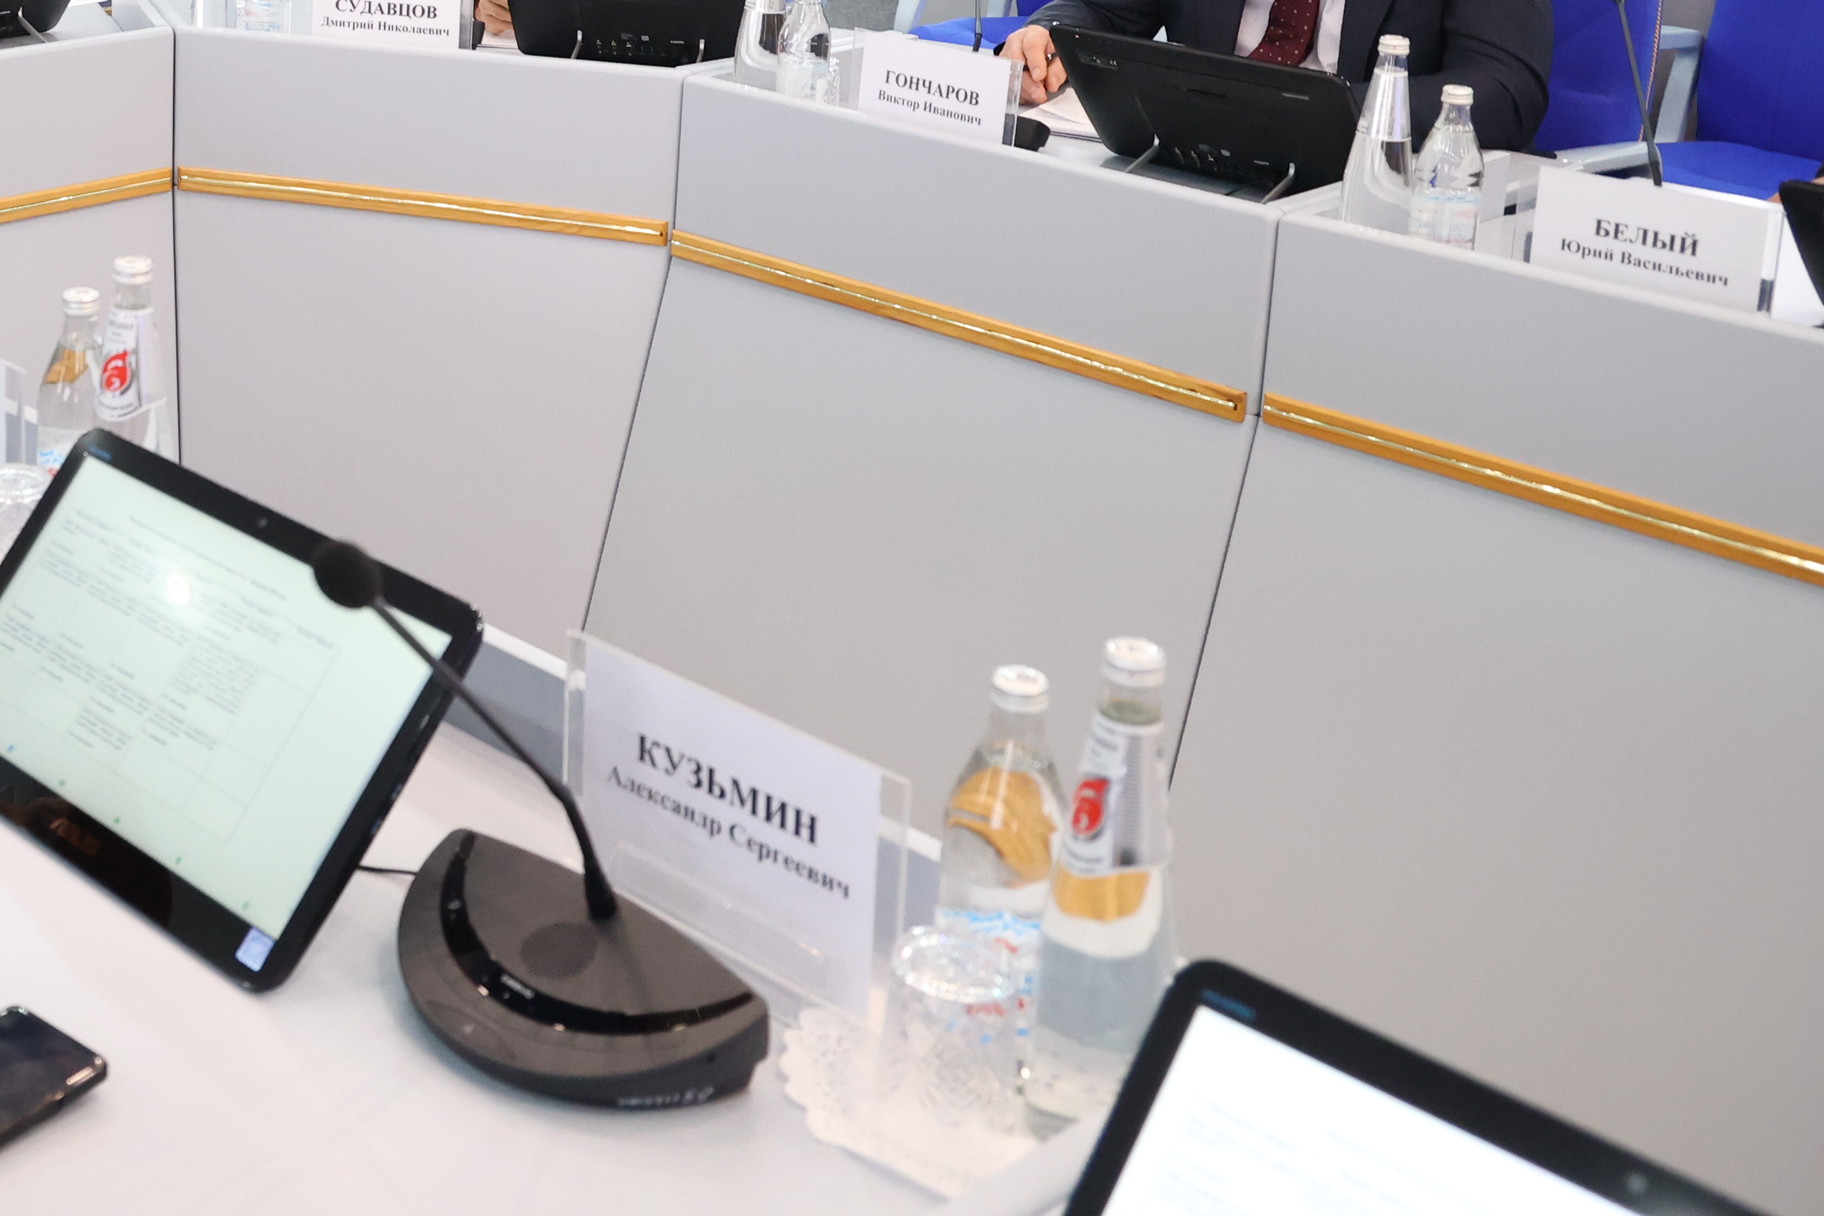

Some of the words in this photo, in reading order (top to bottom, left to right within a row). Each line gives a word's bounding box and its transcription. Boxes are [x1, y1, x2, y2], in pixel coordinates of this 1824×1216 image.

[321, 16, 374, 31] Дмитрий
[378, 21, 450, 36] Николаевич
[878, 89, 920, 112] Виктор
[923, 101, 982, 126] Иванович
[884, 70, 980, 106] ГОНЧАРОВ
[1594, 218, 1699, 257] БЕЛЫЙ
[1561, 238, 1614, 262] Юрий
[1620, 251, 1729, 287] Васильевич
[636, 733, 819, 846] КУЗЬМИН
[607, 765, 722, 839] Александр
[729, 823, 851, 900] Сергеевич
